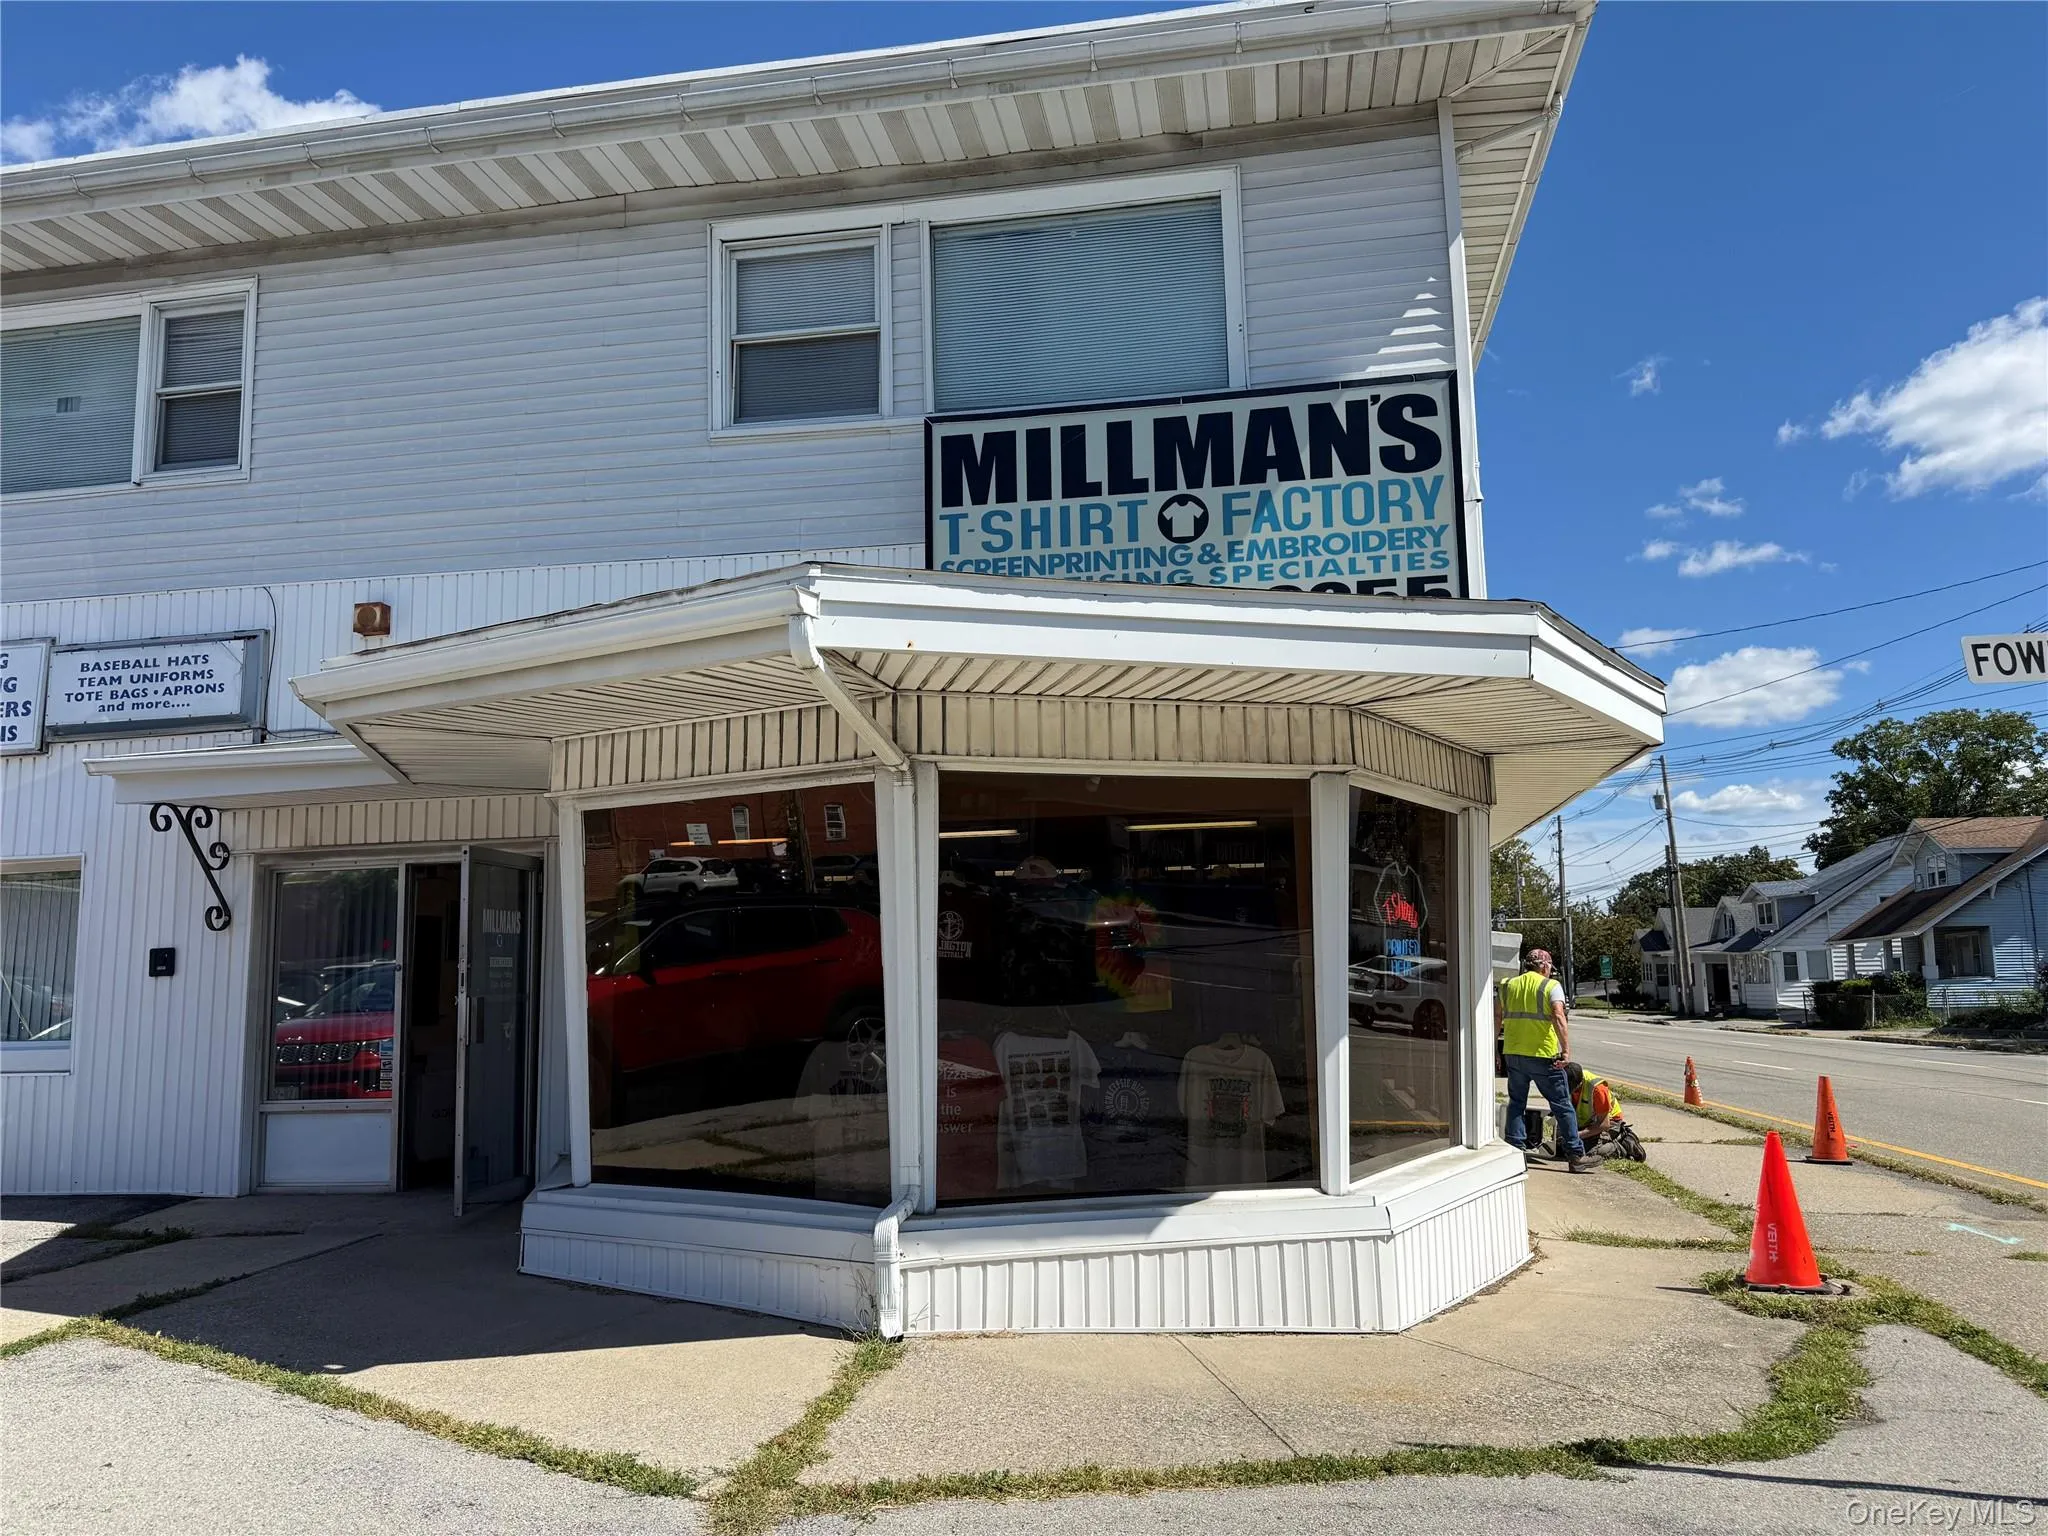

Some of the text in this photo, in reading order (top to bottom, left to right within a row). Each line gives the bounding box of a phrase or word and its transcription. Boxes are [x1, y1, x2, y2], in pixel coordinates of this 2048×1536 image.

[940, 393, 1442, 508] MILLMAN'S
[939, 475, 1444, 555] T-SHIRT FACTORY
[1197, 542, 1224, 565] &
[1227, 524, 1450, 562] EMBROIDERY
[1209, 550, 1450, 585] SPECIALTIES
[80, 654, 209, 672] BASEBALL HATS
[1971, 640, 2048, 677] FOW
[65, 683, 225, 702] TOTE BAGS APRONS
[78, 669, 214, 687] TEAM UNIFORMS
[98, 701, 125, 712] and
[940, 1103, 962, 1116] the
[1767, 1222, 1779, 1263] VEITH
